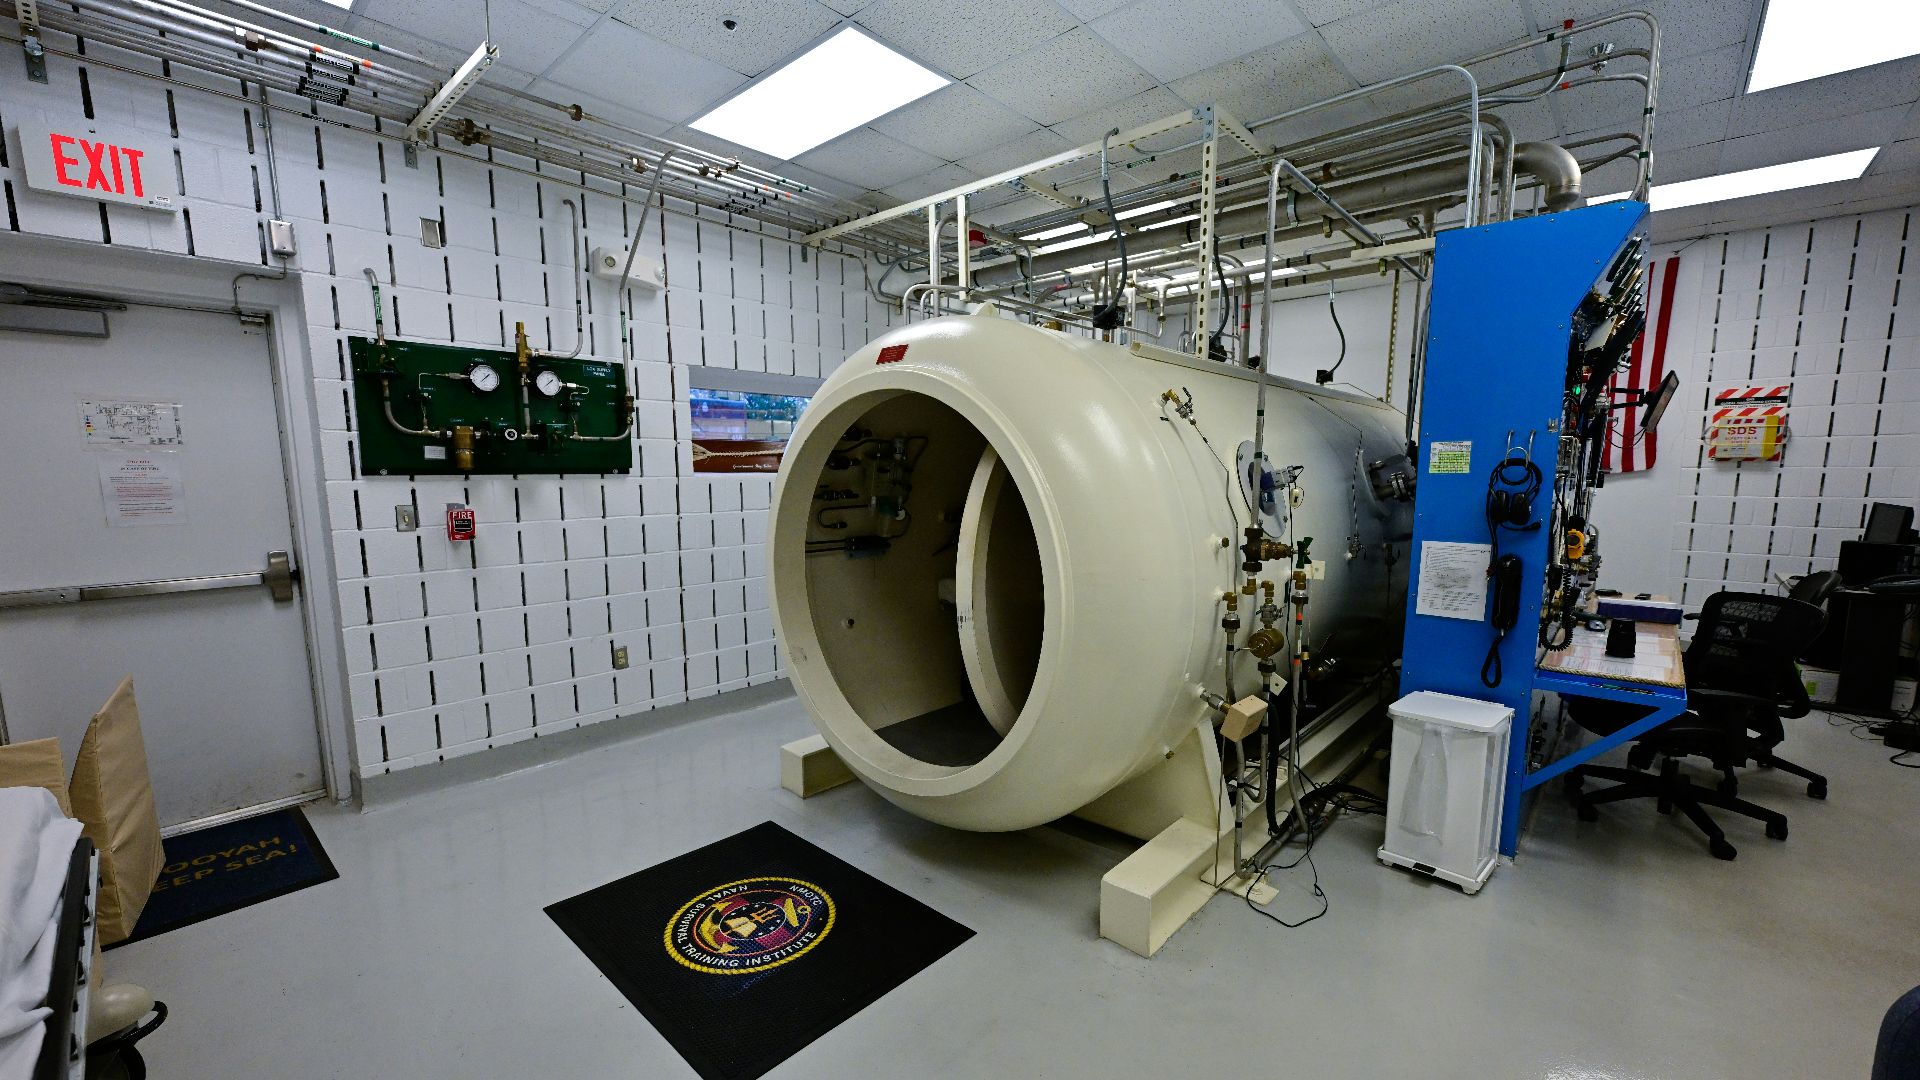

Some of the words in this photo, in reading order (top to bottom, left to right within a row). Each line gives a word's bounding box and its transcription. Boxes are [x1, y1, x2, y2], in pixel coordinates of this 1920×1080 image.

[49, 133, 144, 198] EXIT
[1727, 426, 1757, 435] SDS
[452, 511, 472, 519] FIRE
[152, 868, 215, 893] EEP
[225, 844, 297, 872] SEA!
[162, 836, 281, 875] OOYAH
[706, 885, 748, 902] NAVAL
[677, 902, 706, 944] SURVIVAL
[682, 942, 739, 967] TRAINING
[745, 931, 817, 966] INSTITUTE
